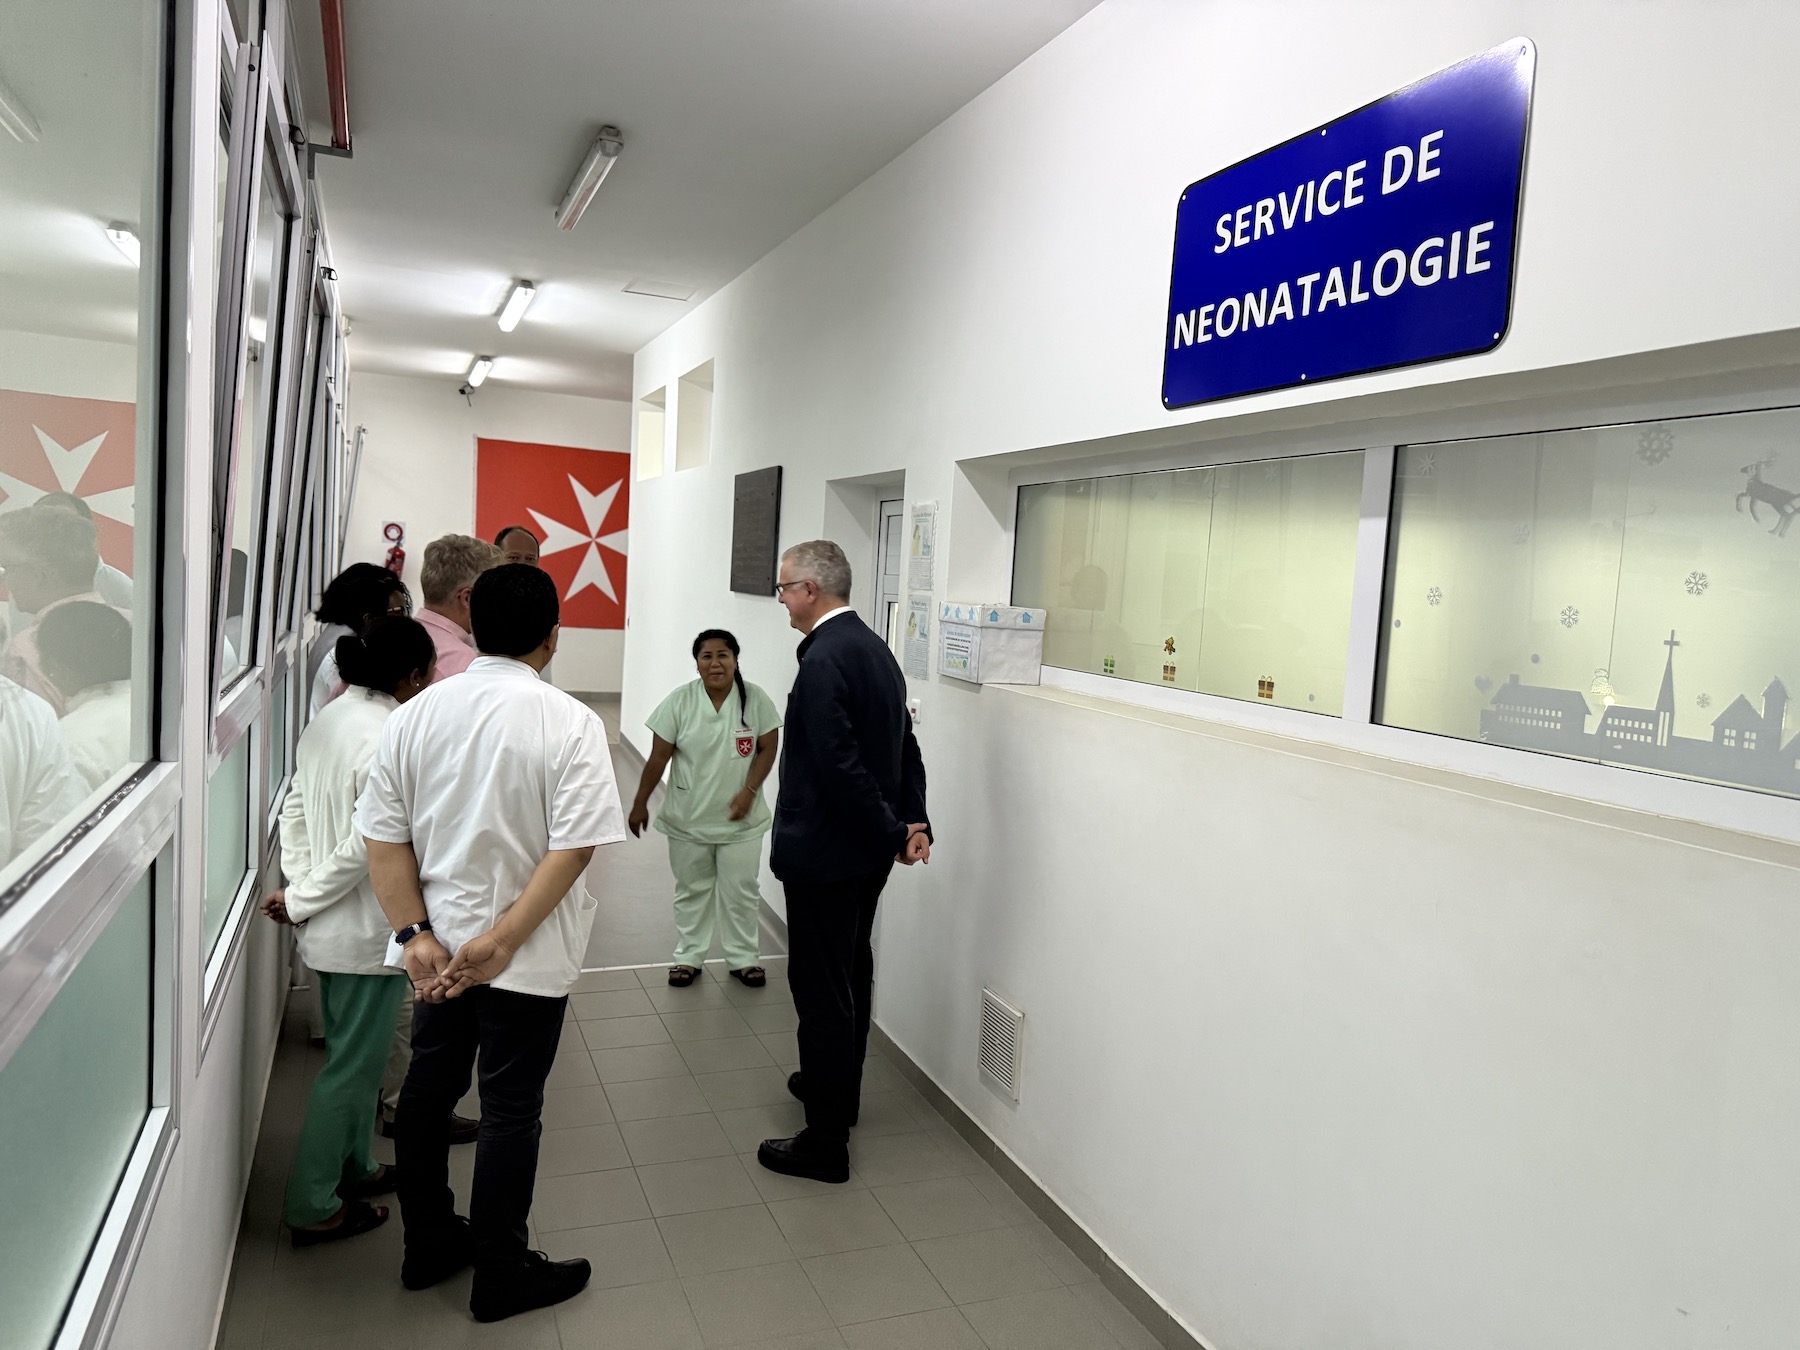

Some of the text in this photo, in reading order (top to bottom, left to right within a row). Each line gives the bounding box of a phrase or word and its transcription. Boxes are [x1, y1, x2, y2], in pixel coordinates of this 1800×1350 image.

[1214, 129, 1444, 254] SERVICE DE
[1173, 221, 1495, 349] NEONATALOGIE
